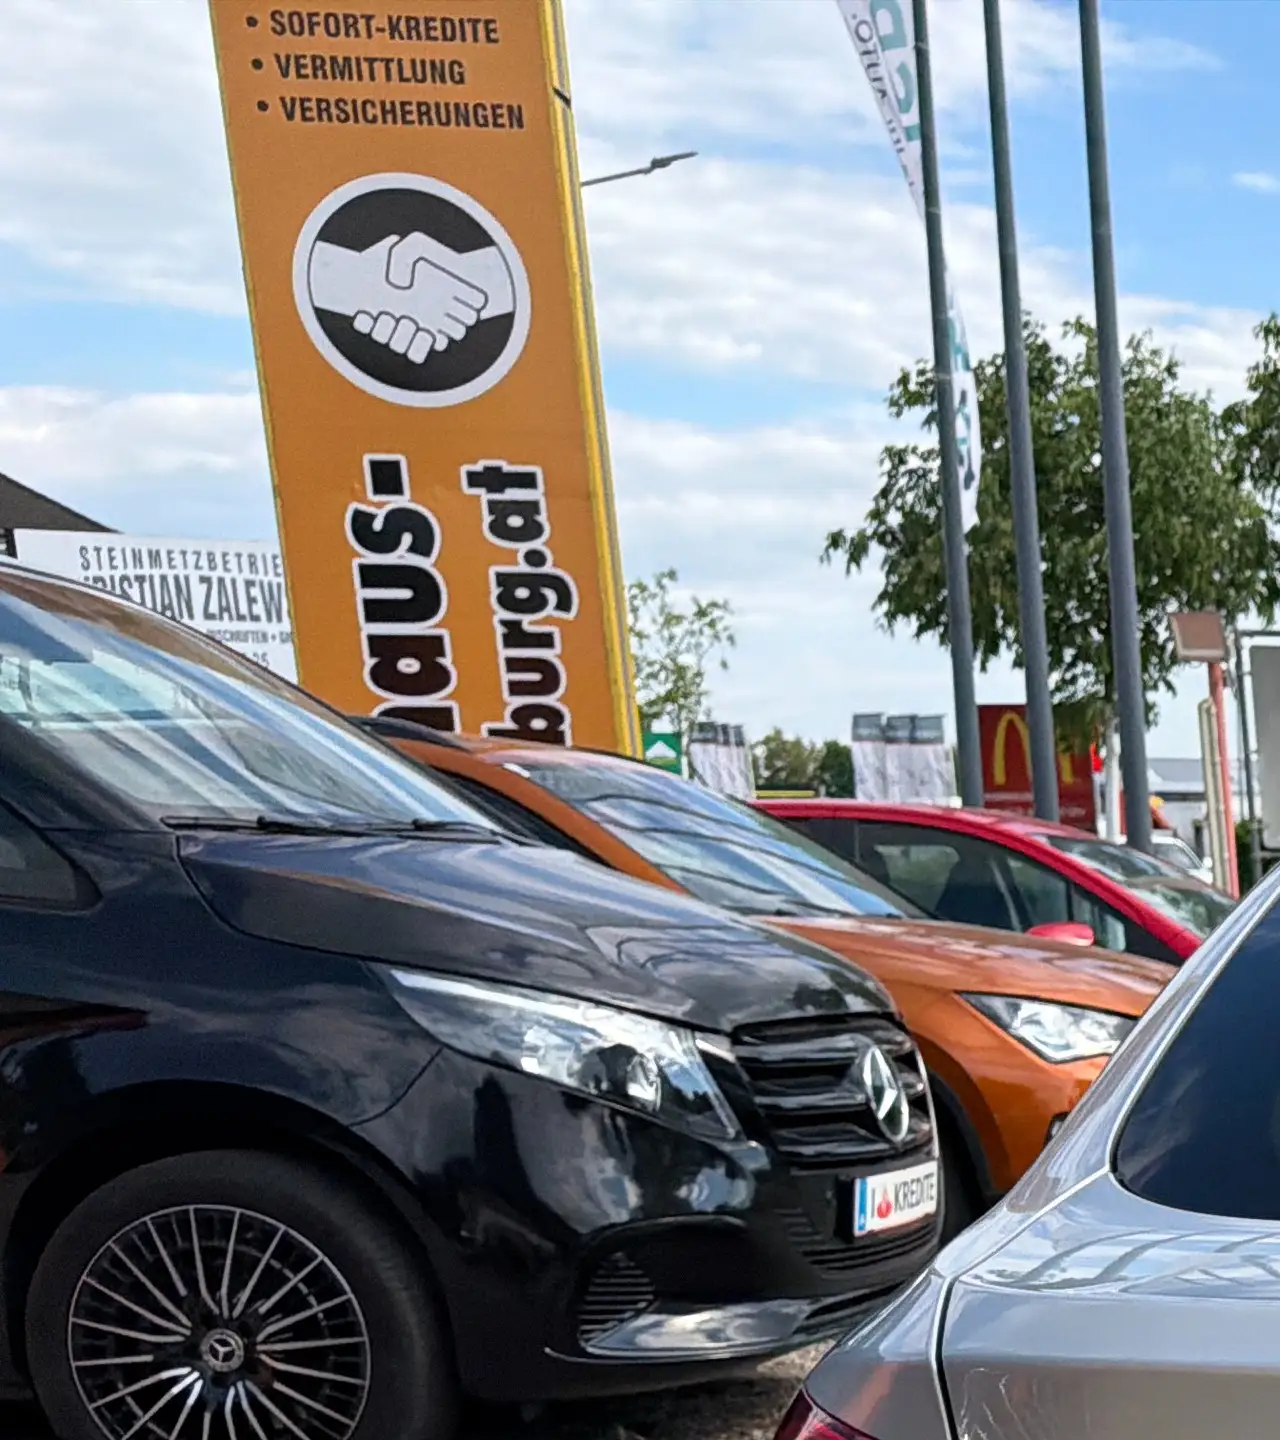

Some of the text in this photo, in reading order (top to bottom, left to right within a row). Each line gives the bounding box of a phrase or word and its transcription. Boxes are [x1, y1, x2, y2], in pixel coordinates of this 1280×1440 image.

[270, 10, 500, 43] SOFORT-KREDITE
[274, 53, 466, 85] VERMITTLUNG
[279, 96, 525, 129] VERSICHERUNGEN
[200, 575, 284, 623] ZALEW
[461, 463, 576, 745] burg.at
[893, 1171, 936, 1213] KREDITE
